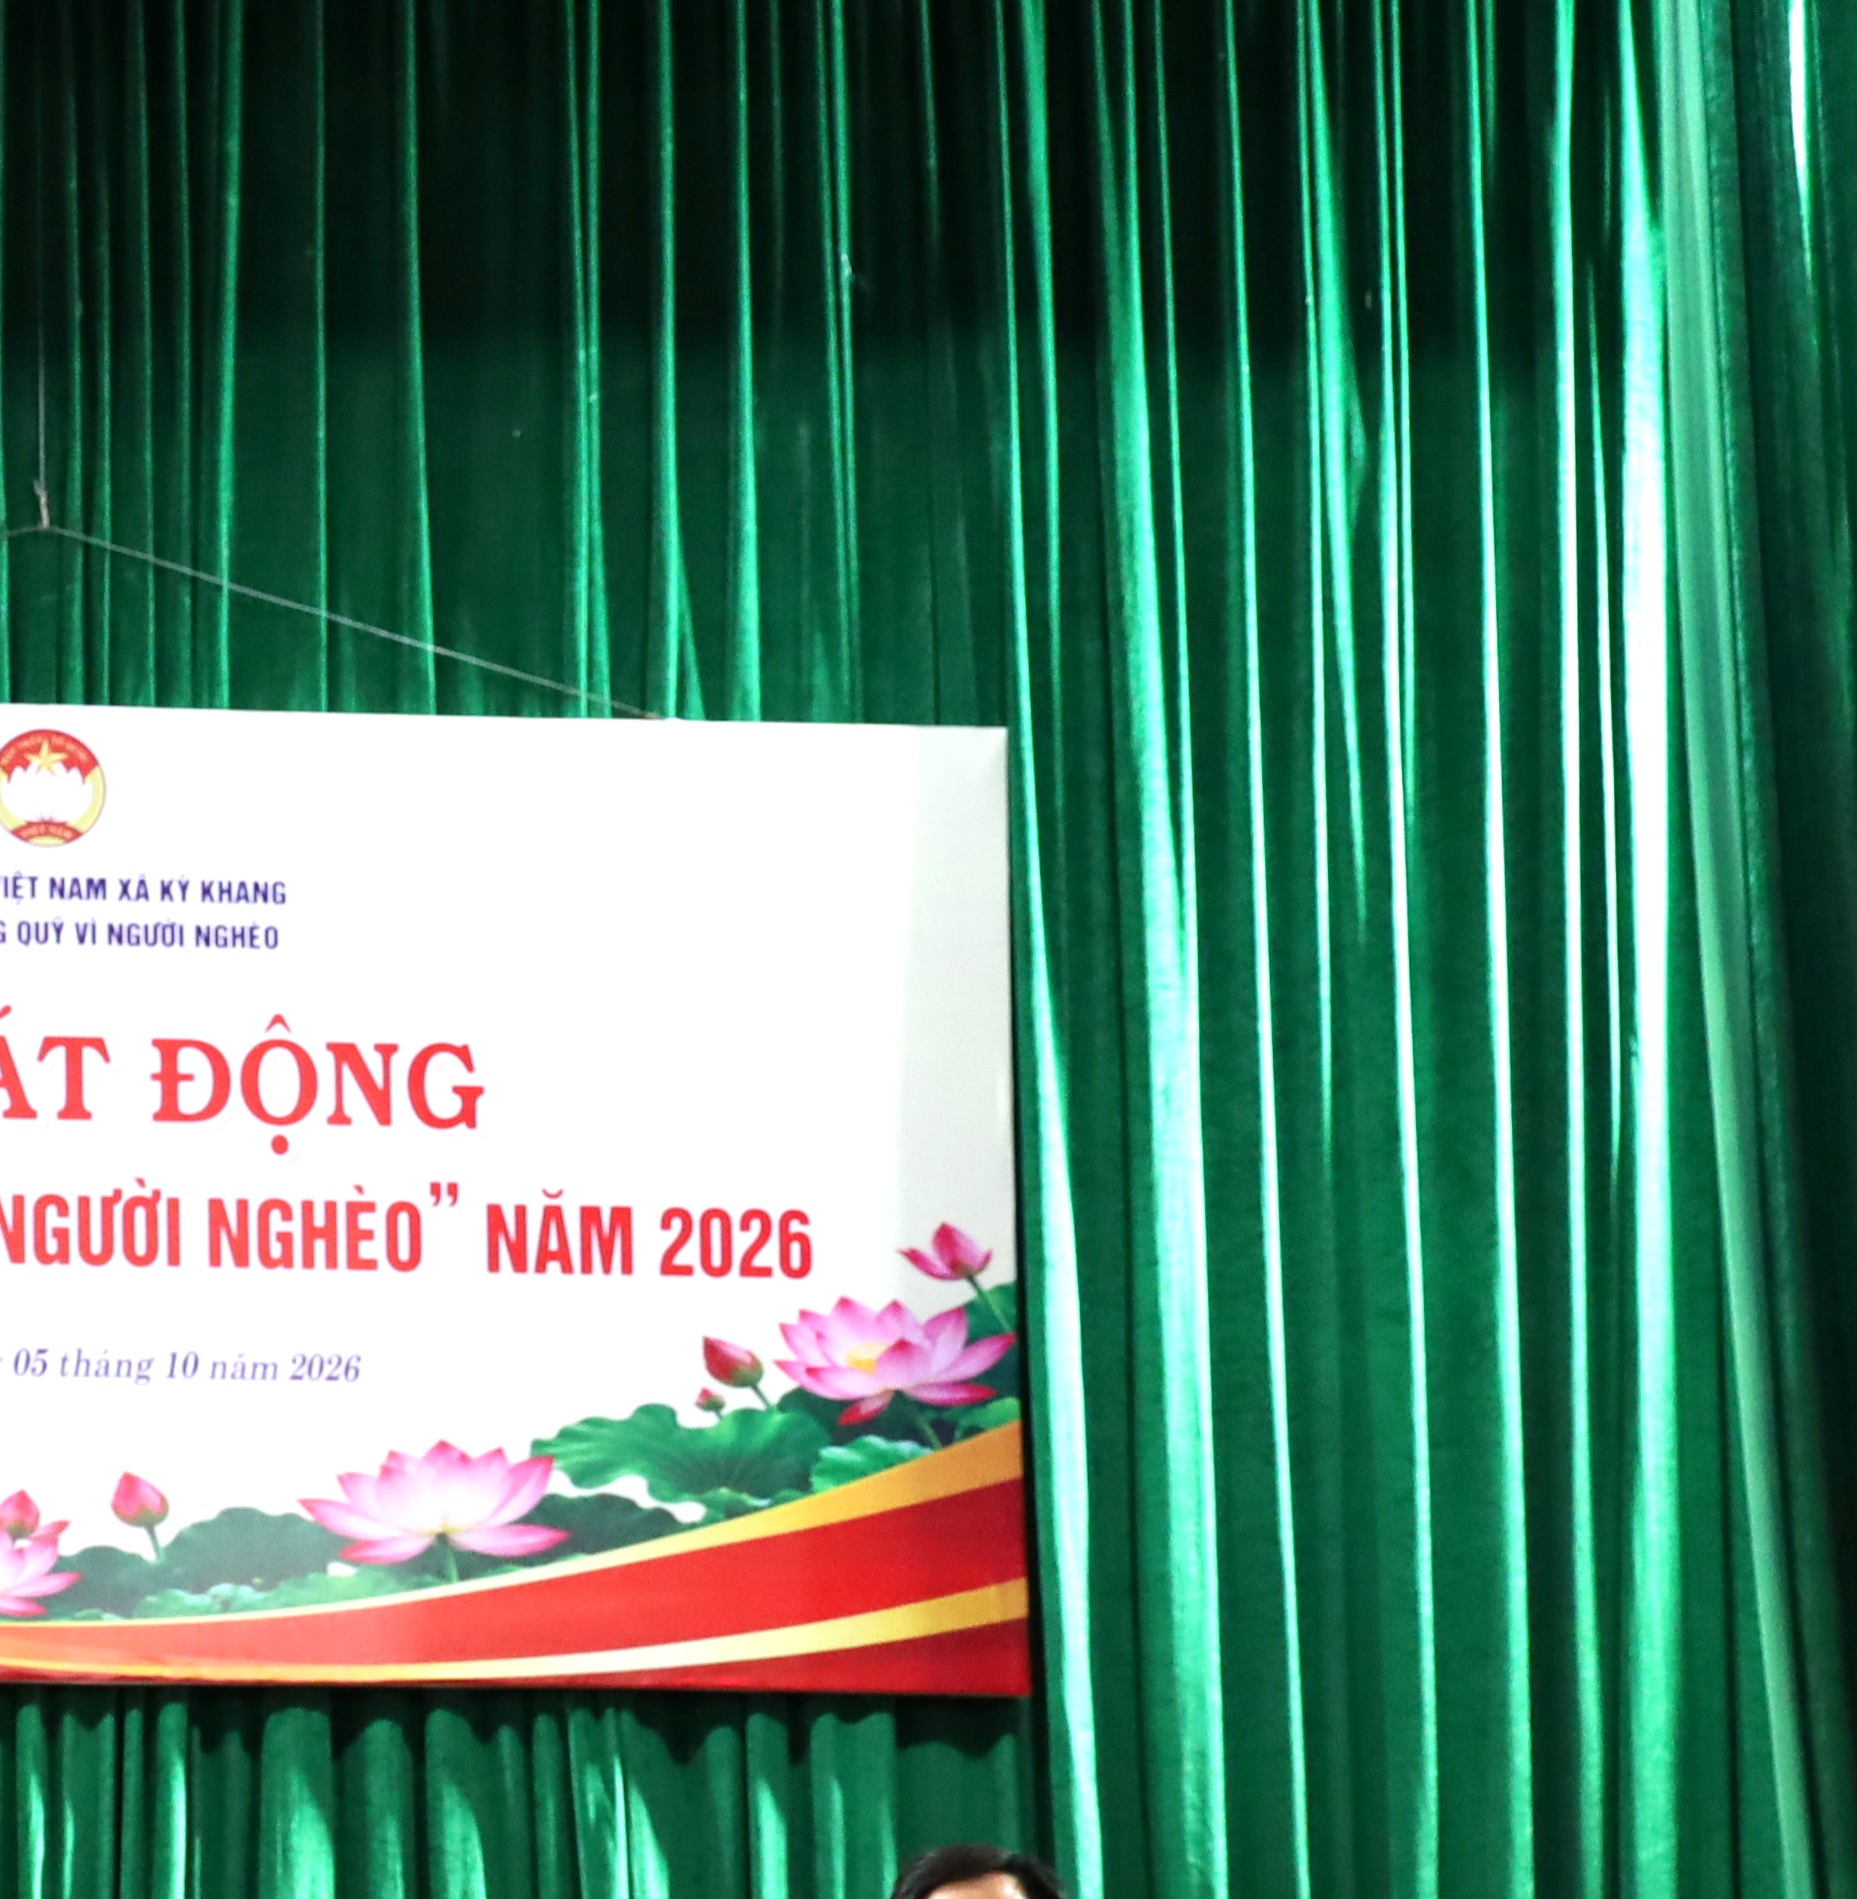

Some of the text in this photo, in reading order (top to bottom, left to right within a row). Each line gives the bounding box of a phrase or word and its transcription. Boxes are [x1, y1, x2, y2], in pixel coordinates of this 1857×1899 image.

[49, 877, 107, 900] NAM
[118, 873, 150, 902] XÃ
[201, 880, 286, 905] KHANG
[75, 920, 96, 945] VÌ
[107, 919, 184, 948] NGƯỜI
[195, 923, 278, 949] NGHÈO
[151, 1014, 484, 1155] ĐỘNG
[486, 1189, 633, 1276] NĂM
[660, 1207, 812, 1279] 2026
[13, 1348, 48, 1377] 05
[60, 1348, 154, 1384] tháng
[167, 1352, 199, 1379] 10
[210, 1354, 278, 1380] năm
[290, 1354, 361, 1381] 2026
